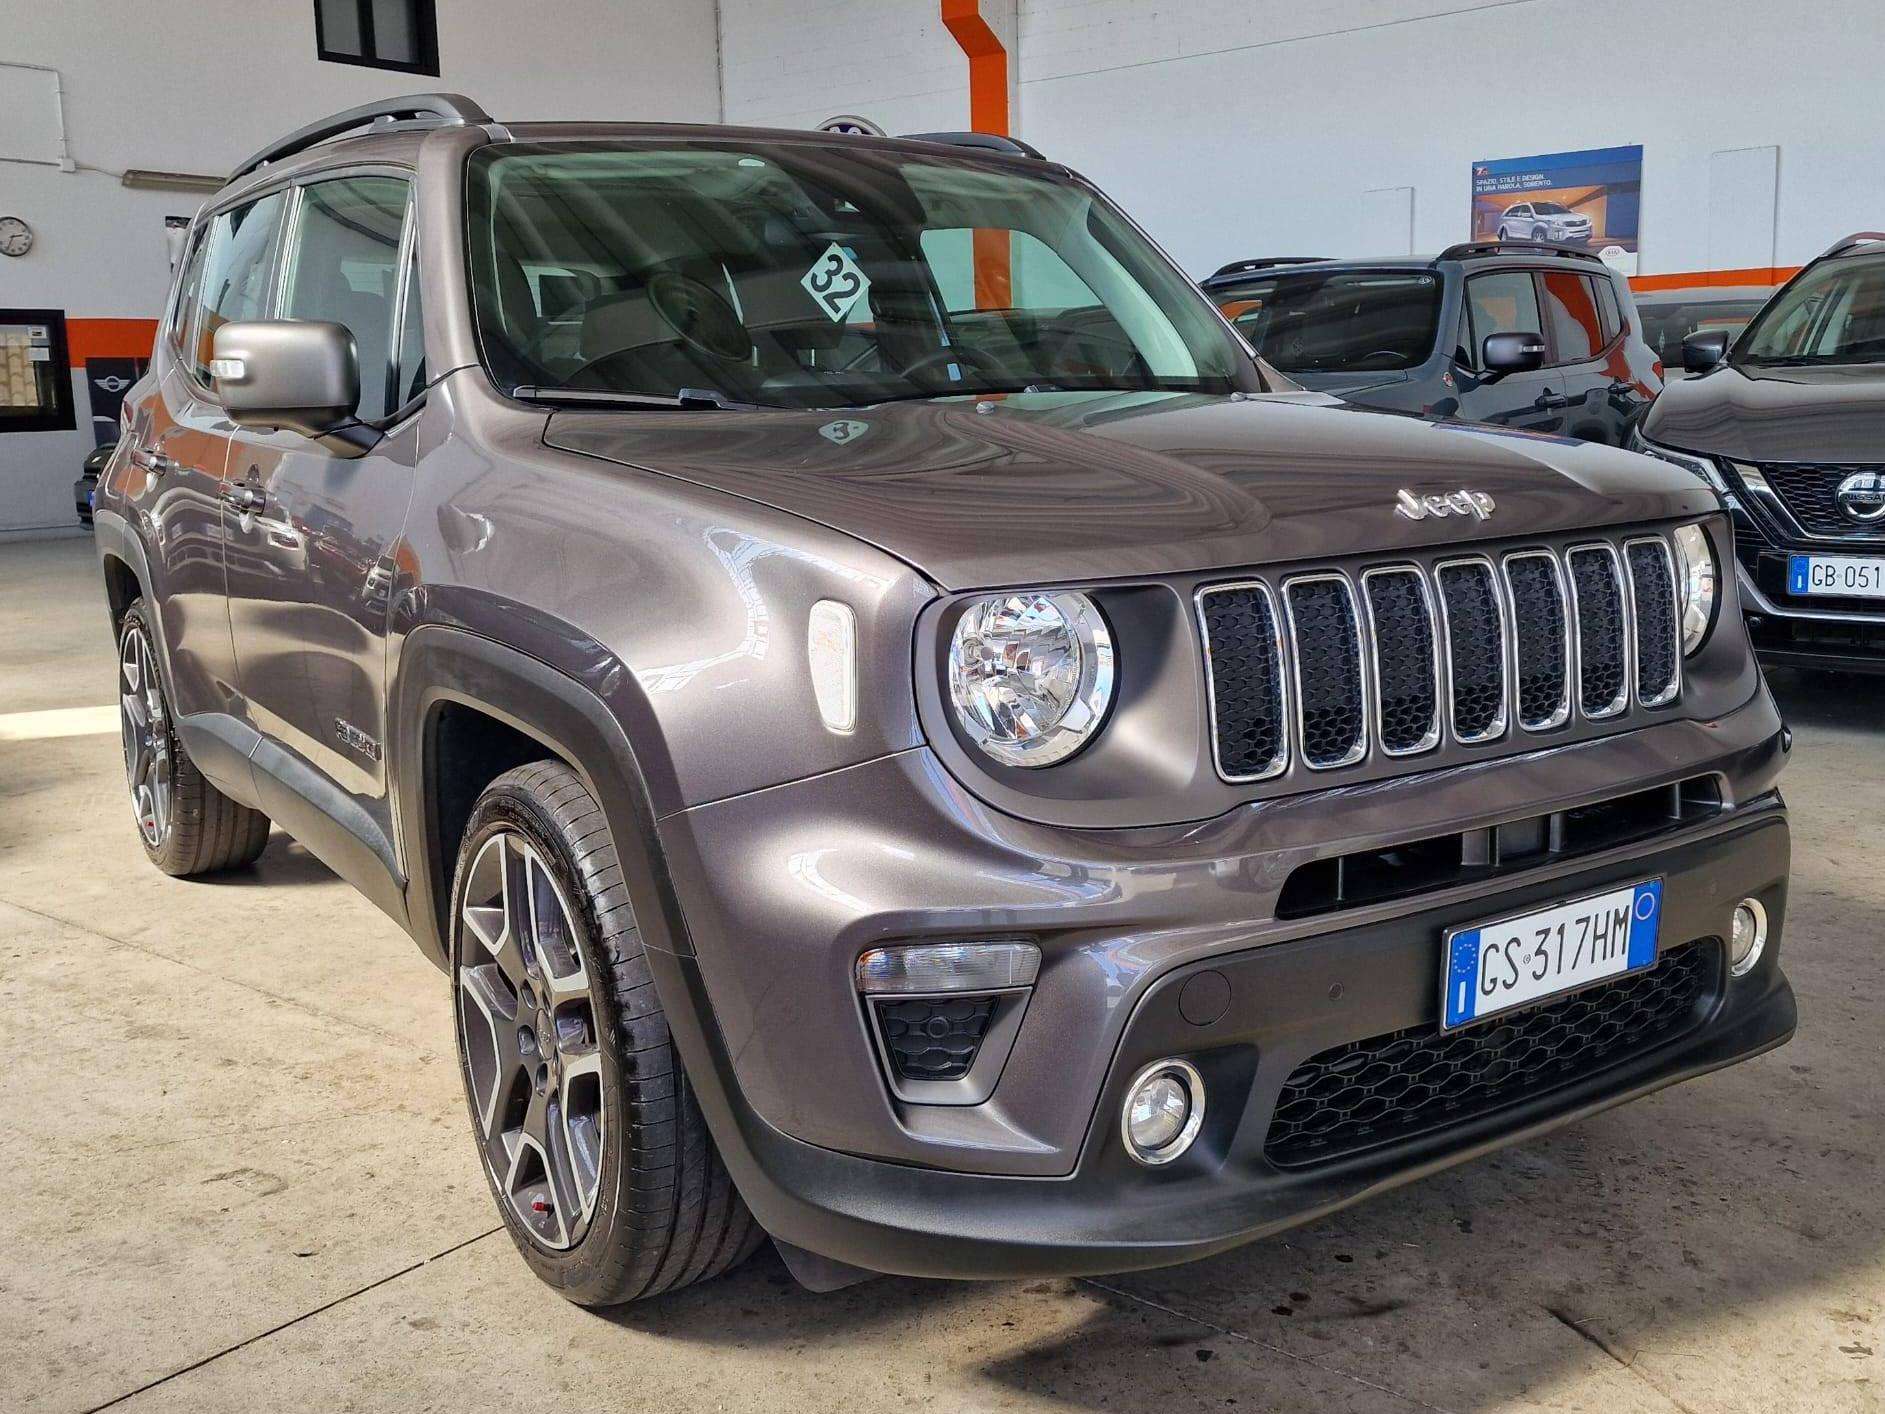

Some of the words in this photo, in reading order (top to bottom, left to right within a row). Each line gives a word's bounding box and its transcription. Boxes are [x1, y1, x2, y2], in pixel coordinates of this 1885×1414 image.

[810, 253, 861, 314] 32
[1394, 488, 1496, 521] Jeep
[1812, 564, 1836, 587] GB
[1844, 565, 1880, 588] 051
[1480, 937, 1522, 996] GS
[1532, 904, 1631, 981] 317HM
